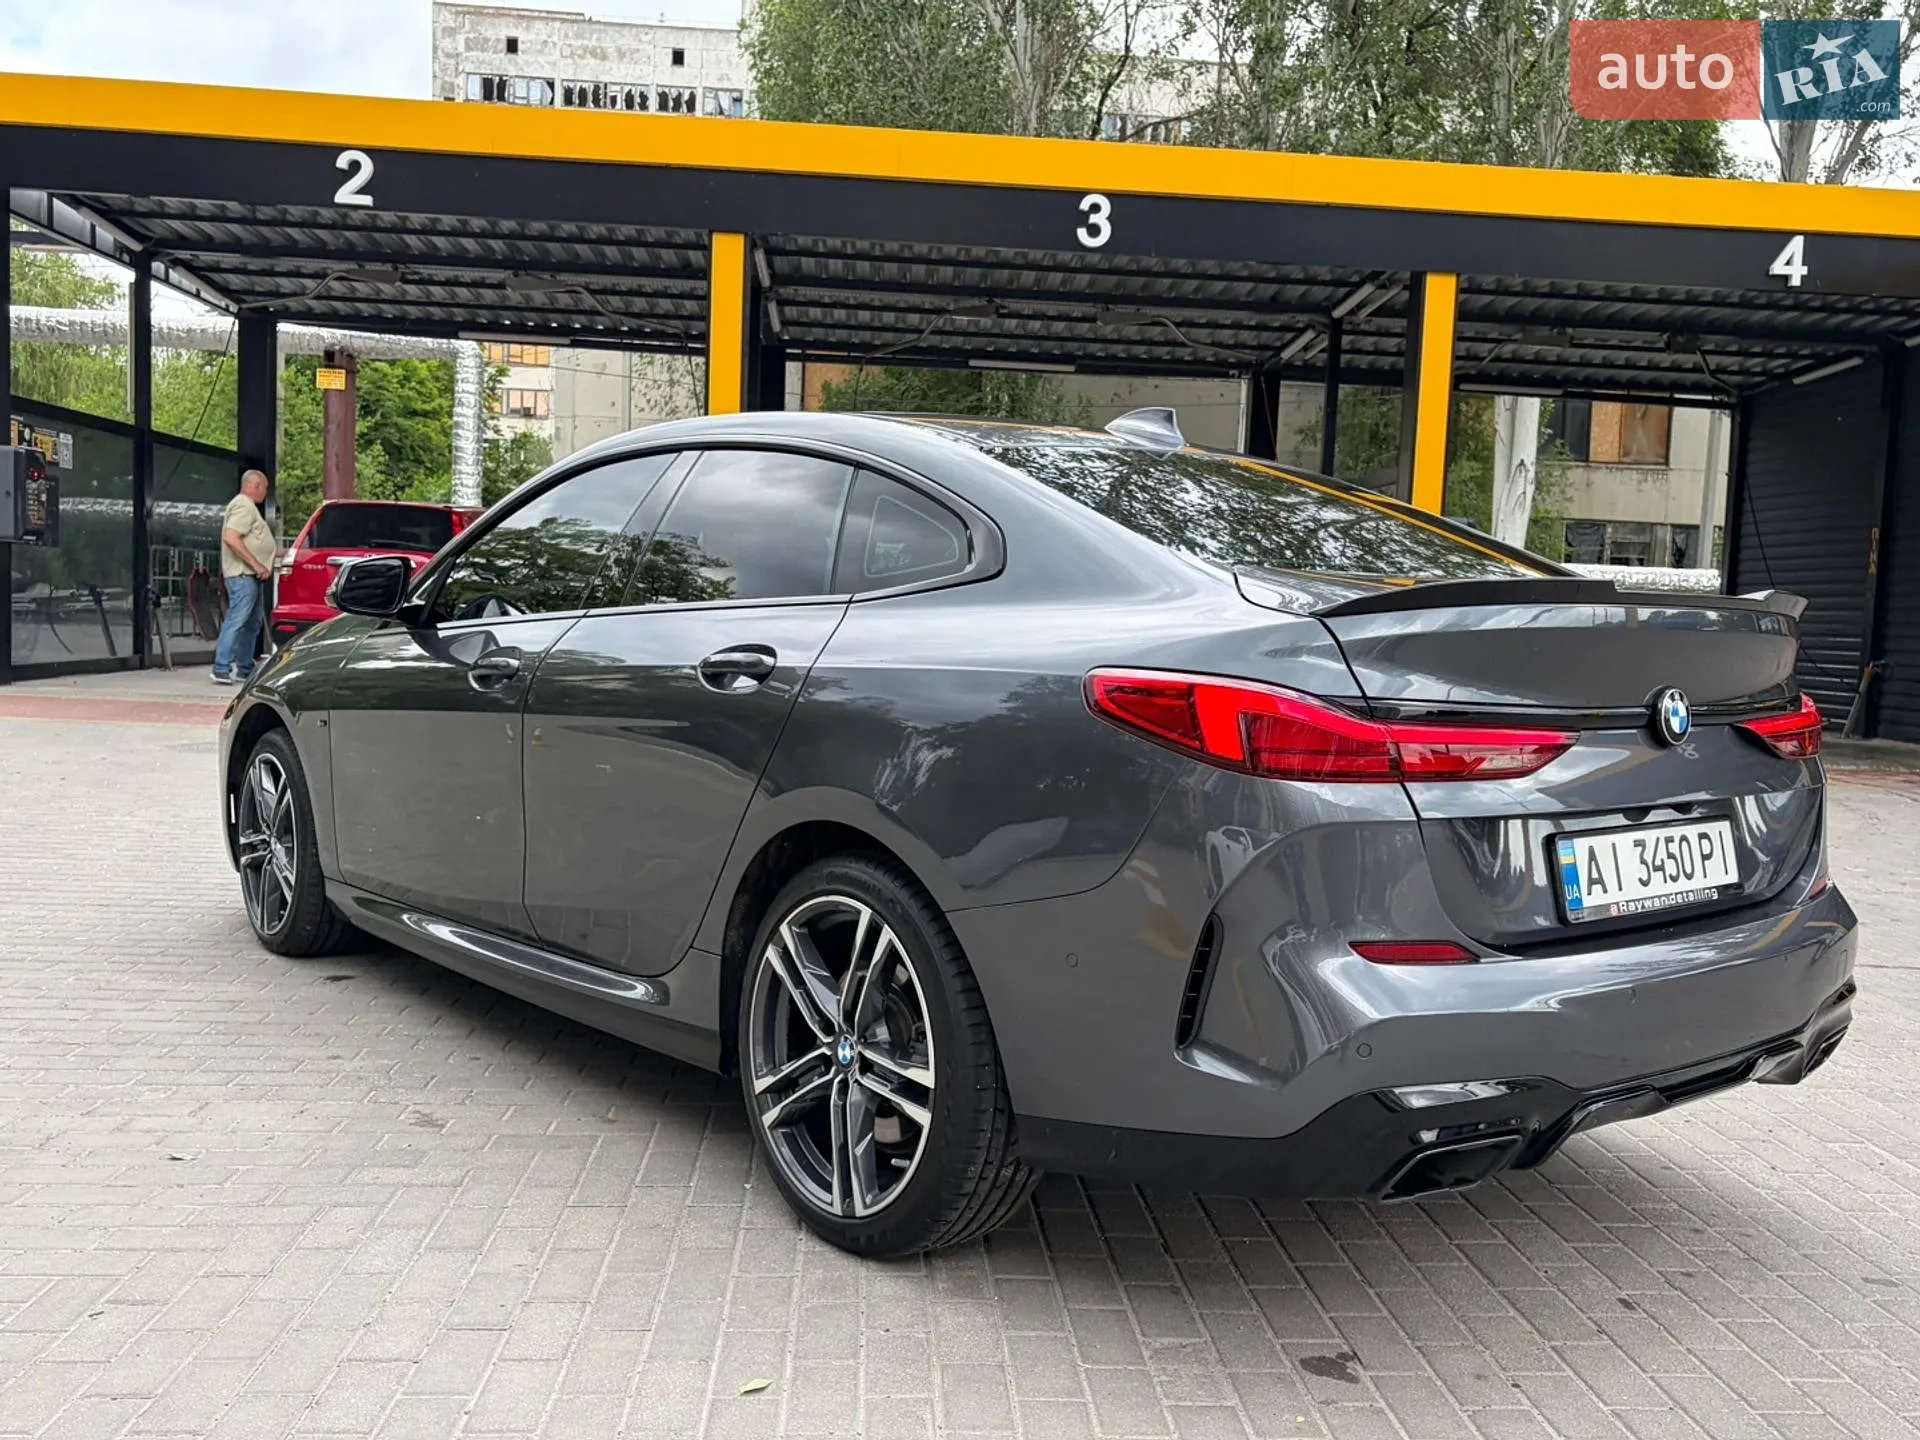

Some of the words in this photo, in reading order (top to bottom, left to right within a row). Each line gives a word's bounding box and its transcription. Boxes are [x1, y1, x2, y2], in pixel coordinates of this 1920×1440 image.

[333, 149, 375, 207] 2
[1076, 193, 1112, 248] 3
[1768, 234, 1808, 287] 4
[1564, 884, 1581, 900] UA
[1586, 842, 1623, 896] AI
[1633, 834, 1695, 888] 3450
